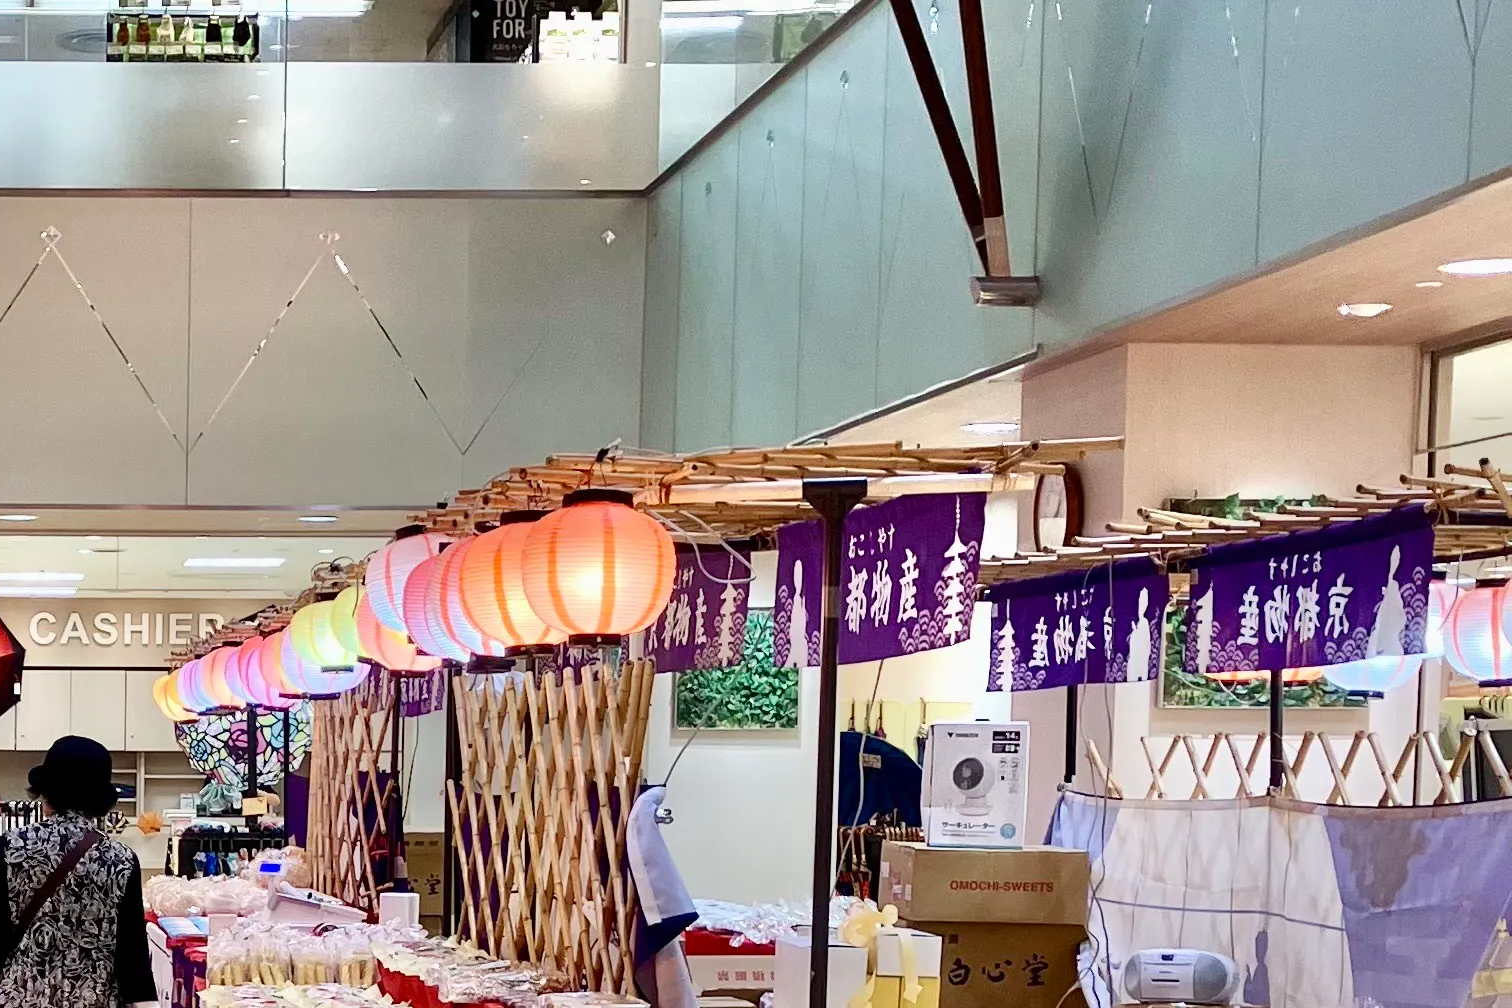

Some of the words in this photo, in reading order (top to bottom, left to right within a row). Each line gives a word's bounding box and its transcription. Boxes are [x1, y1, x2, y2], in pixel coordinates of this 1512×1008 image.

[493, 20, 526, 39] FOR
[949, 880, 1055, 893] OMOCHI-SWEETS
[947, 952, 1050, 987] 白心堂
